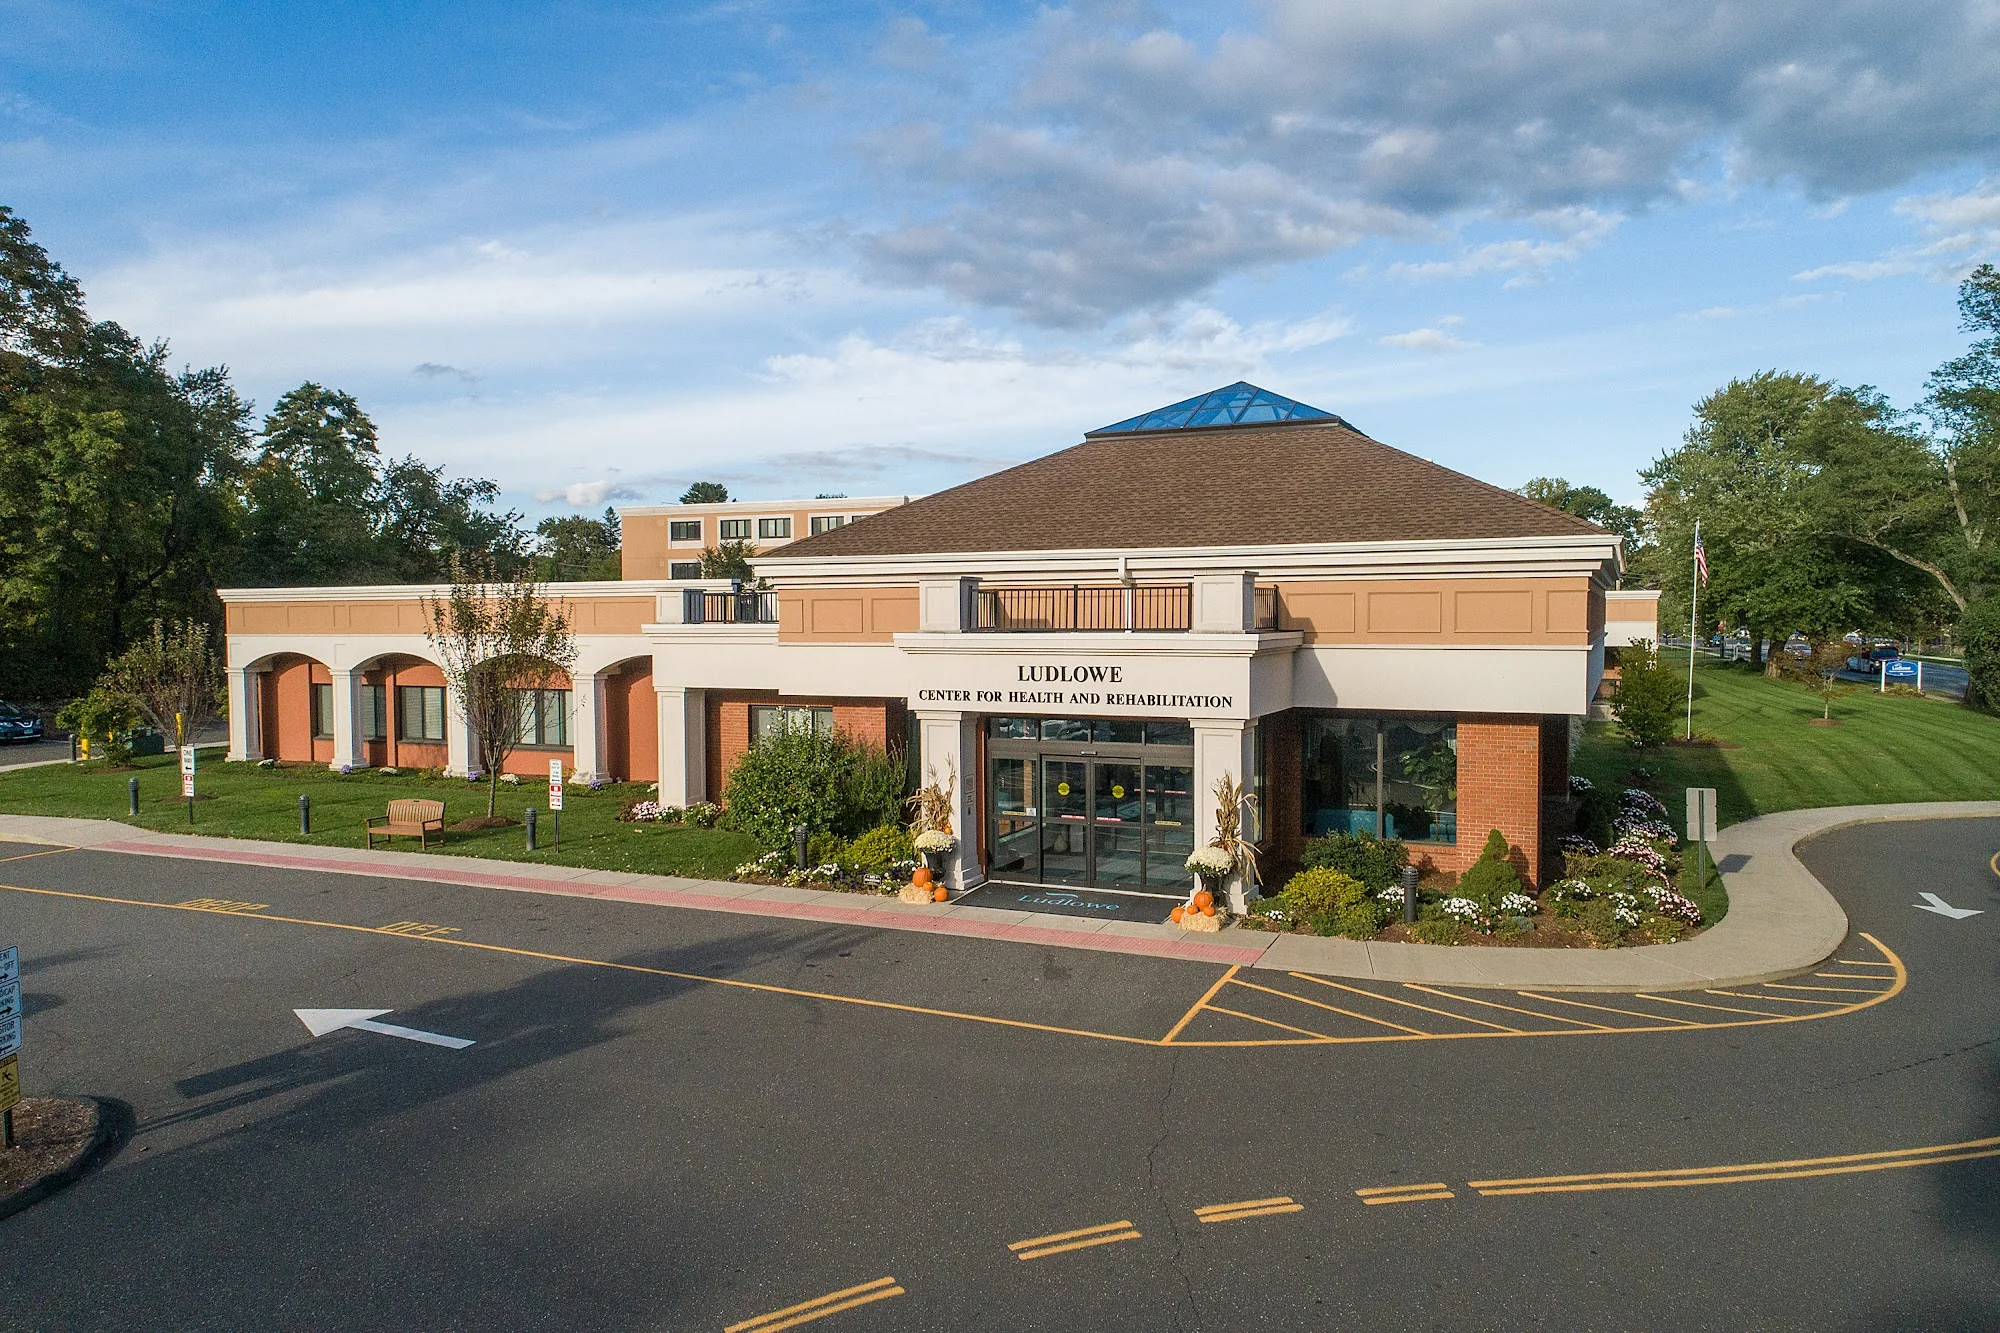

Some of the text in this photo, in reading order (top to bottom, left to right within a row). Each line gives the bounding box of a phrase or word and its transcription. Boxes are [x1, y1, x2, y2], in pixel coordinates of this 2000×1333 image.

[1017, 665, 1123, 683] LUDLOWE
[918, 689, 1233, 708] CENTER FOR HEALTH AND REHABILITATION
[1018, 895, 1120, 910] Ludlowe
[375, 921, 463, 936] OFF
